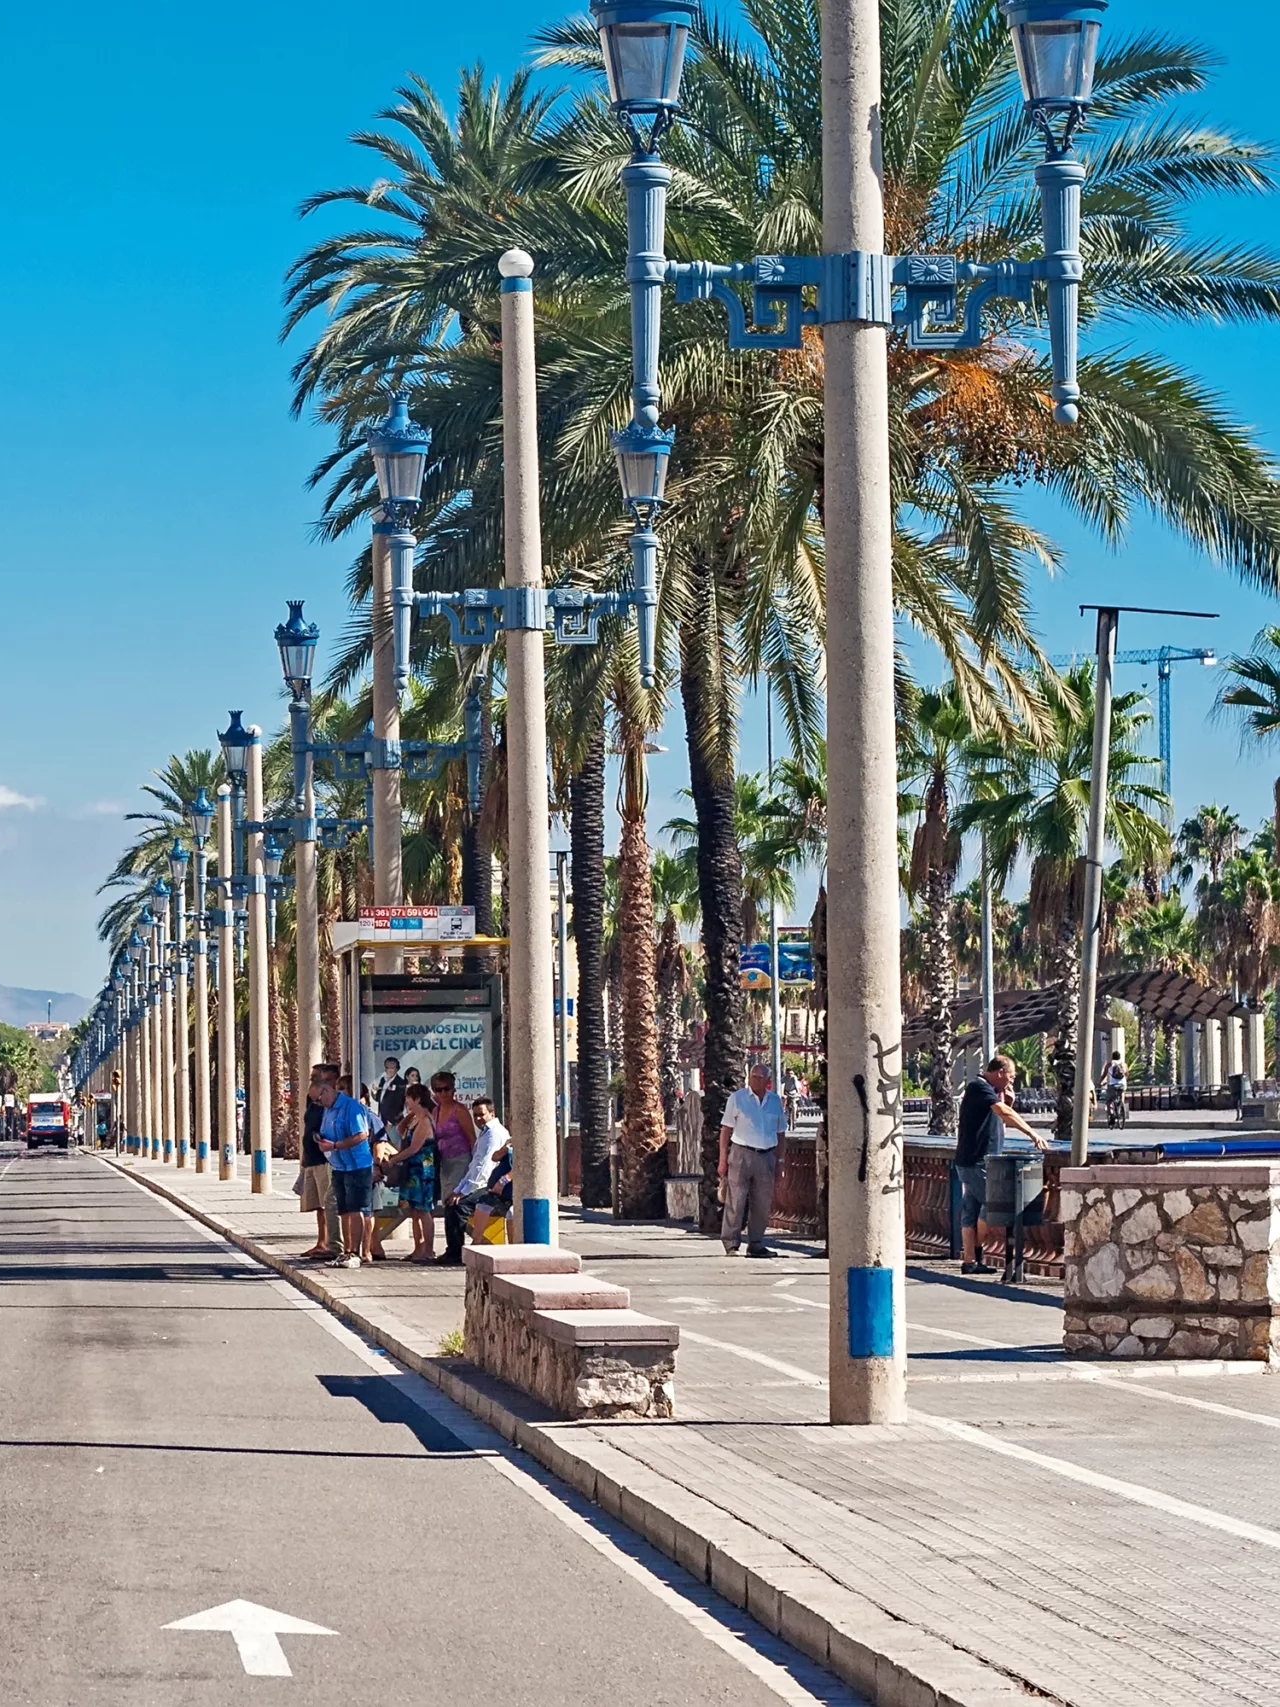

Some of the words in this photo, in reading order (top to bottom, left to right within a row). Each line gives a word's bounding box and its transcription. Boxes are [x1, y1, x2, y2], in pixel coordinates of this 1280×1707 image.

[359, 908, 369, 916] 14
[391, 908, 402, 916] 57
[406, 908, 418, 916] 59
[422, 908, 434, 916] 64
[375, 919, 388, 927] 157
[370, 1025, 381, 1035] TE
[384, 1024, 451, 1035] ESPERAMOS
[453, 1024, 468, 1033] EN
[470, 1023, 485, 1033] LA
[373, 1038, 417, 1051] FIESTA
[421, 1038, 447, 1051] DEL
[449, 1037, 482, 1050] CINE
[462, 1080, 487, 1089] cine
